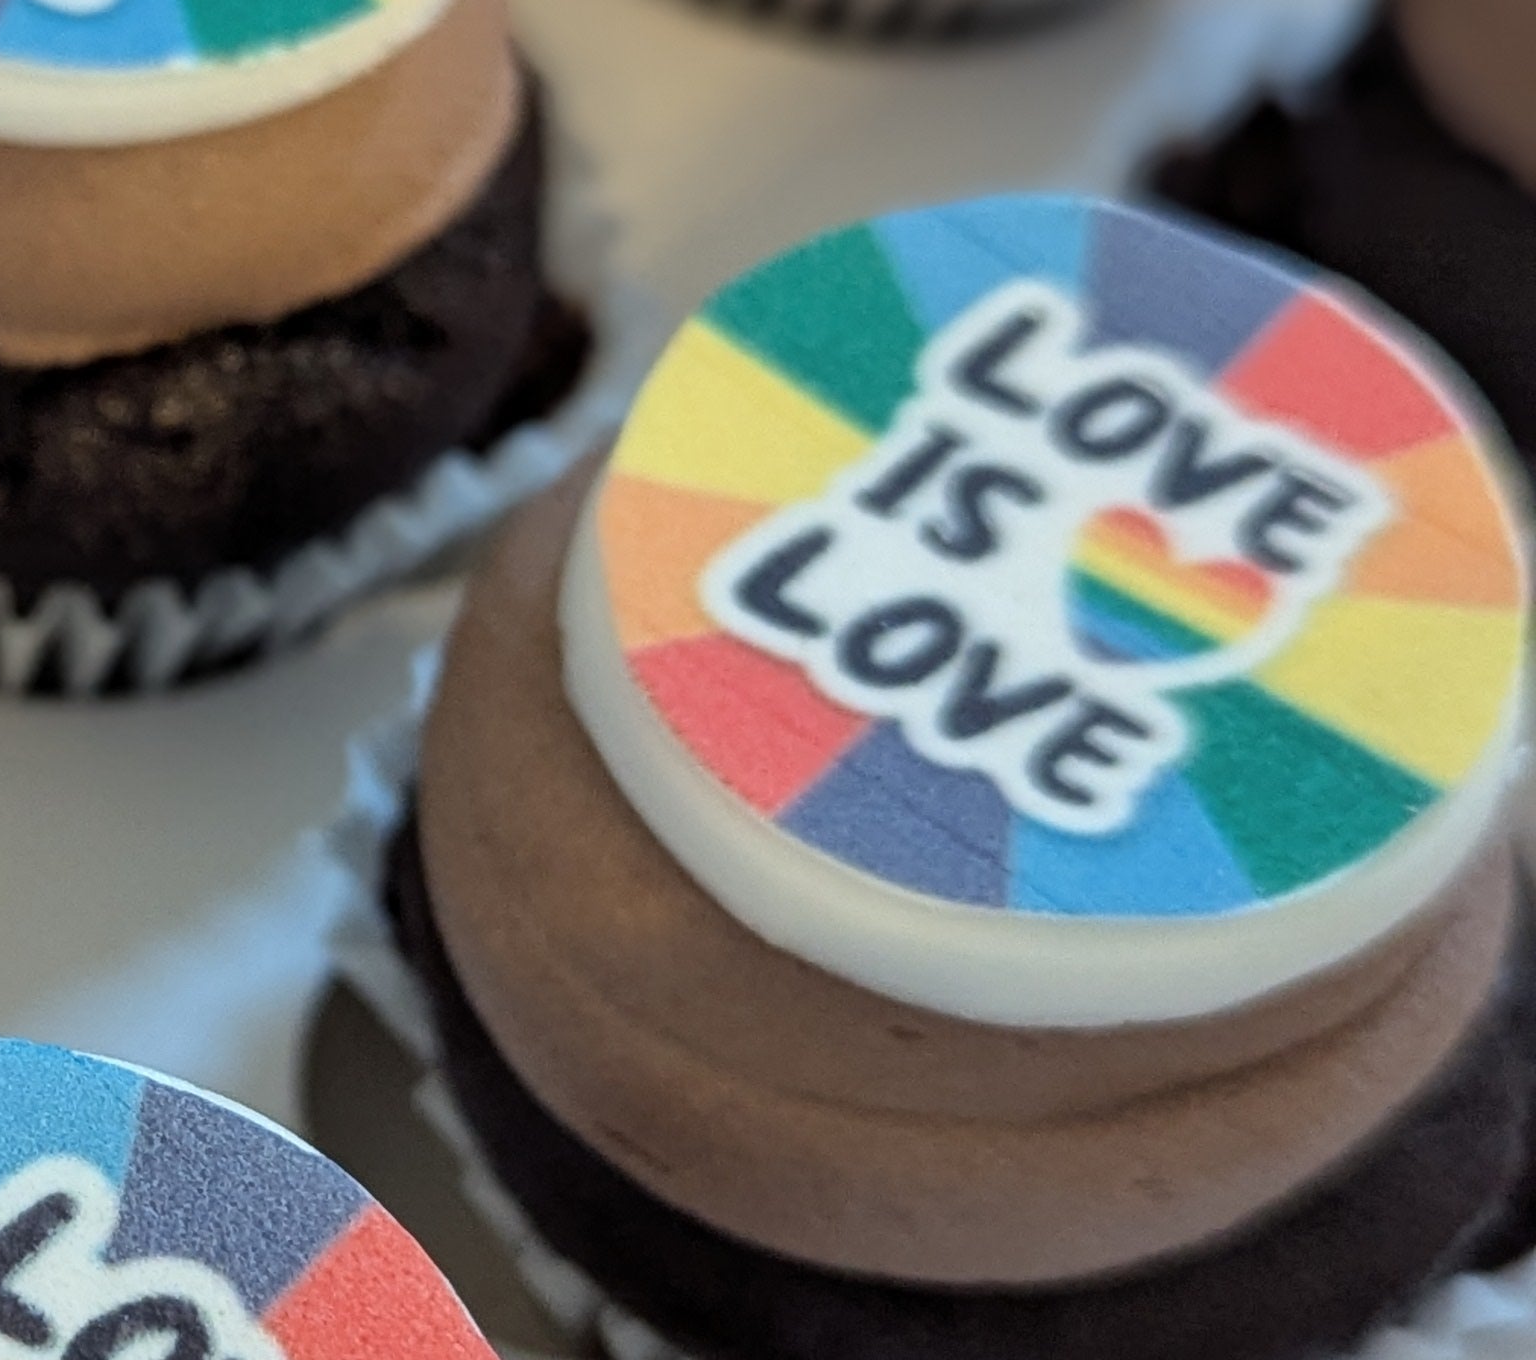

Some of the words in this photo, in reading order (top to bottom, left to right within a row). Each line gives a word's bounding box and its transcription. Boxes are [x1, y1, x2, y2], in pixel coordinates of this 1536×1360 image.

[856, 424, 1045, 563] IS
[950, 311, 1348, 575] LOVE
[734, 527, 1153, 808] LOVE
